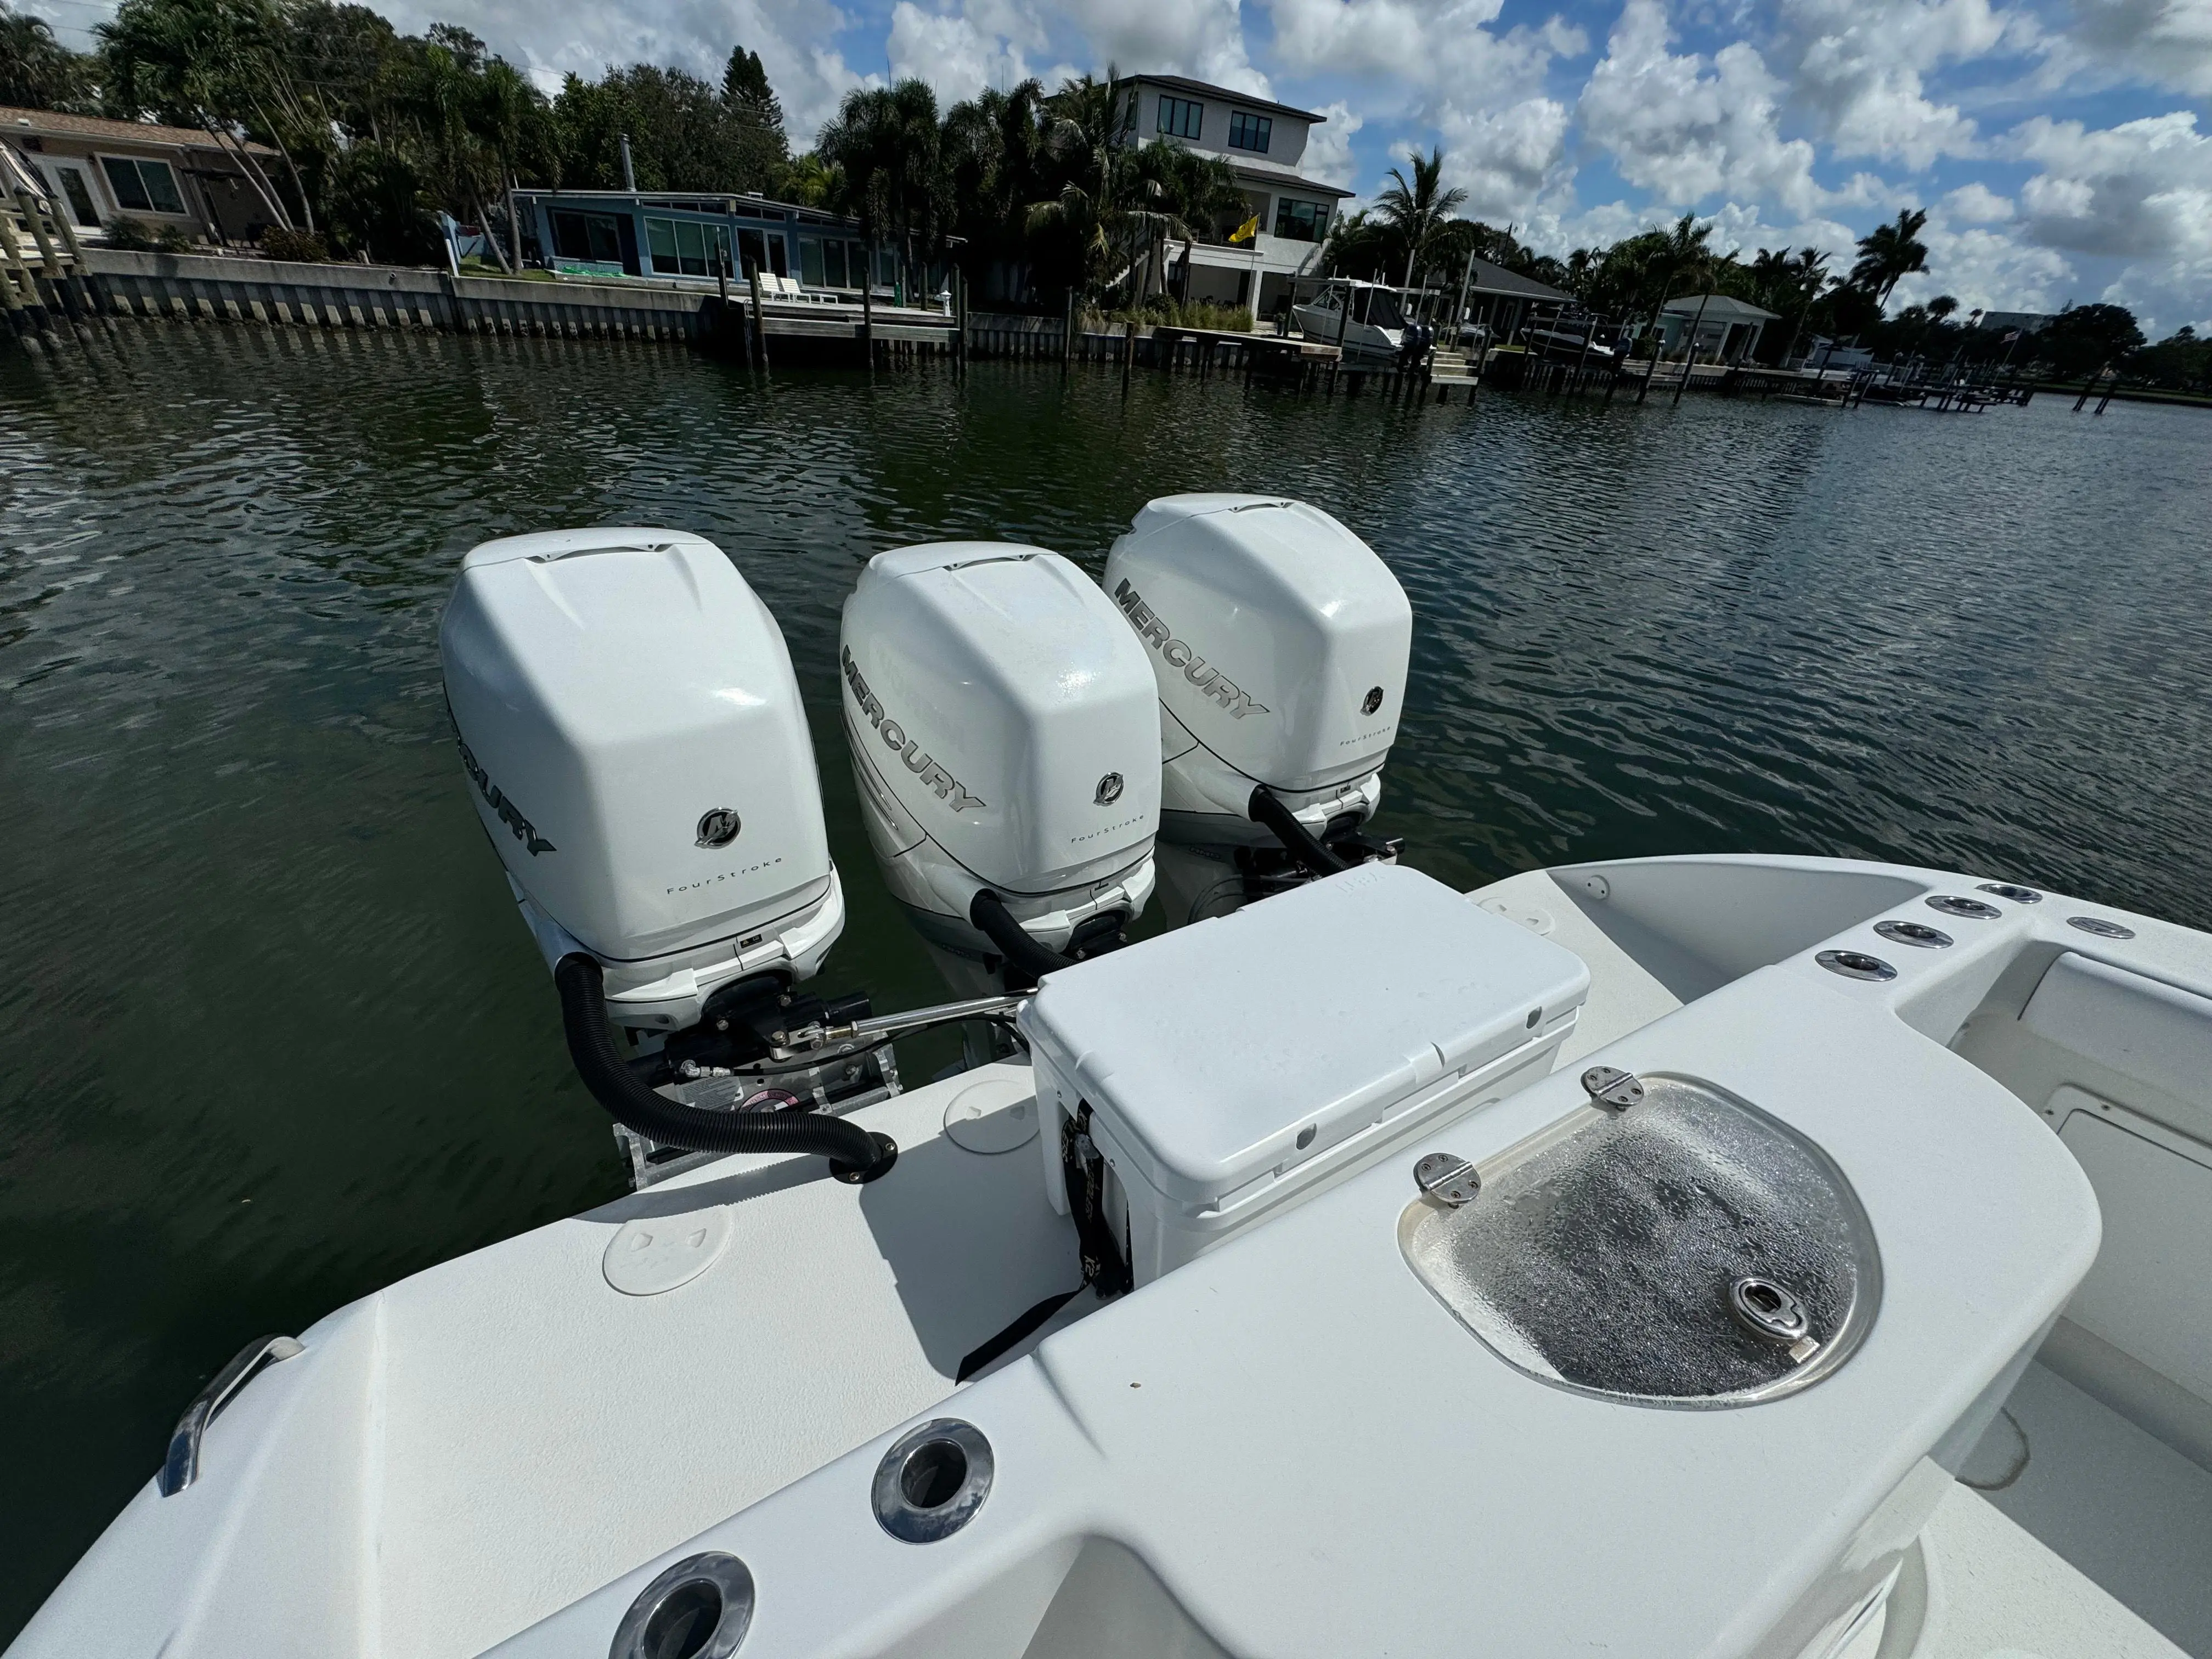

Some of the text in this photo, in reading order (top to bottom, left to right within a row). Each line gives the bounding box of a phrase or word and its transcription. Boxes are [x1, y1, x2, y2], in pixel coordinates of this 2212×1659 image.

[1114, 577, 1271, 720] MERCURY
[842, 645, 987, 812] MERCURY
[458, 742, 557, 856] CURY
[1071, 815, 1144, 843] FourStroke
[666, 857, 782, 895] FourStroke
[1084, 1255, 1096, 1277] K2
